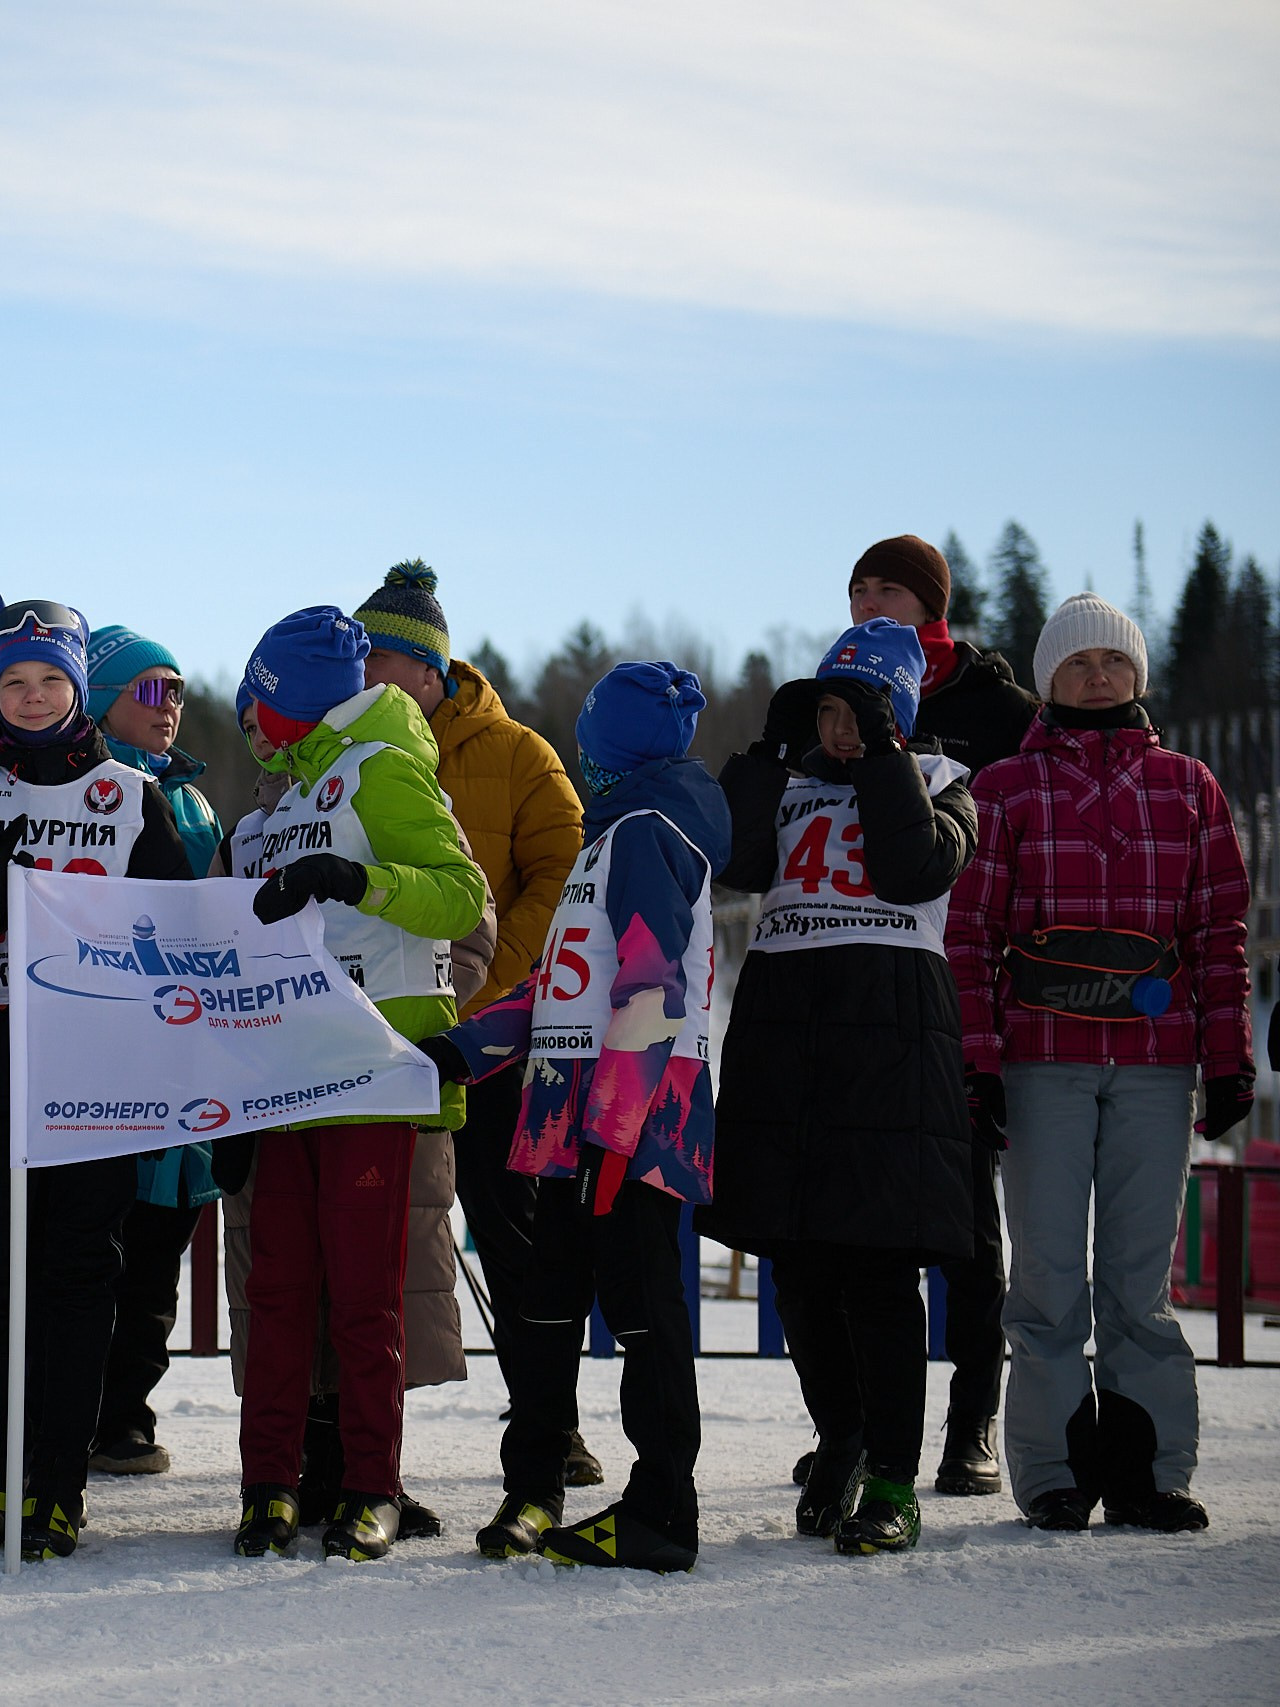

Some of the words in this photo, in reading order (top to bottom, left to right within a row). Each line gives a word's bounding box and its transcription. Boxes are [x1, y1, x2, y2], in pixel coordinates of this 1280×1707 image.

[30, 635, 55, 643] ВРЕМЯ
[857, 666, 878, 676] БЫТЬ
[784, 816, 875, 898] 43
[830, 903, 862, 913] лыжный
[863, 907, 895, 917] комплекс
[199, 939, 234, 947] INSULATORS
[165, 949, 241, 978] INSTA
[200, 971, 331, 1012] ЭНЕРГИЯ
[1041, 973, 1140, 1009] swix
[208, 1017, 229, 1028] ДЛЯ
[233, 1014, 282, 1029] ЖИЗНИ
[242, 1074, 372, 1113] FORENERGO
[44, 1101, 169, 1118] ФОРЭНЕРГО
[580, 1168, 591, 1204] NORDSKI
